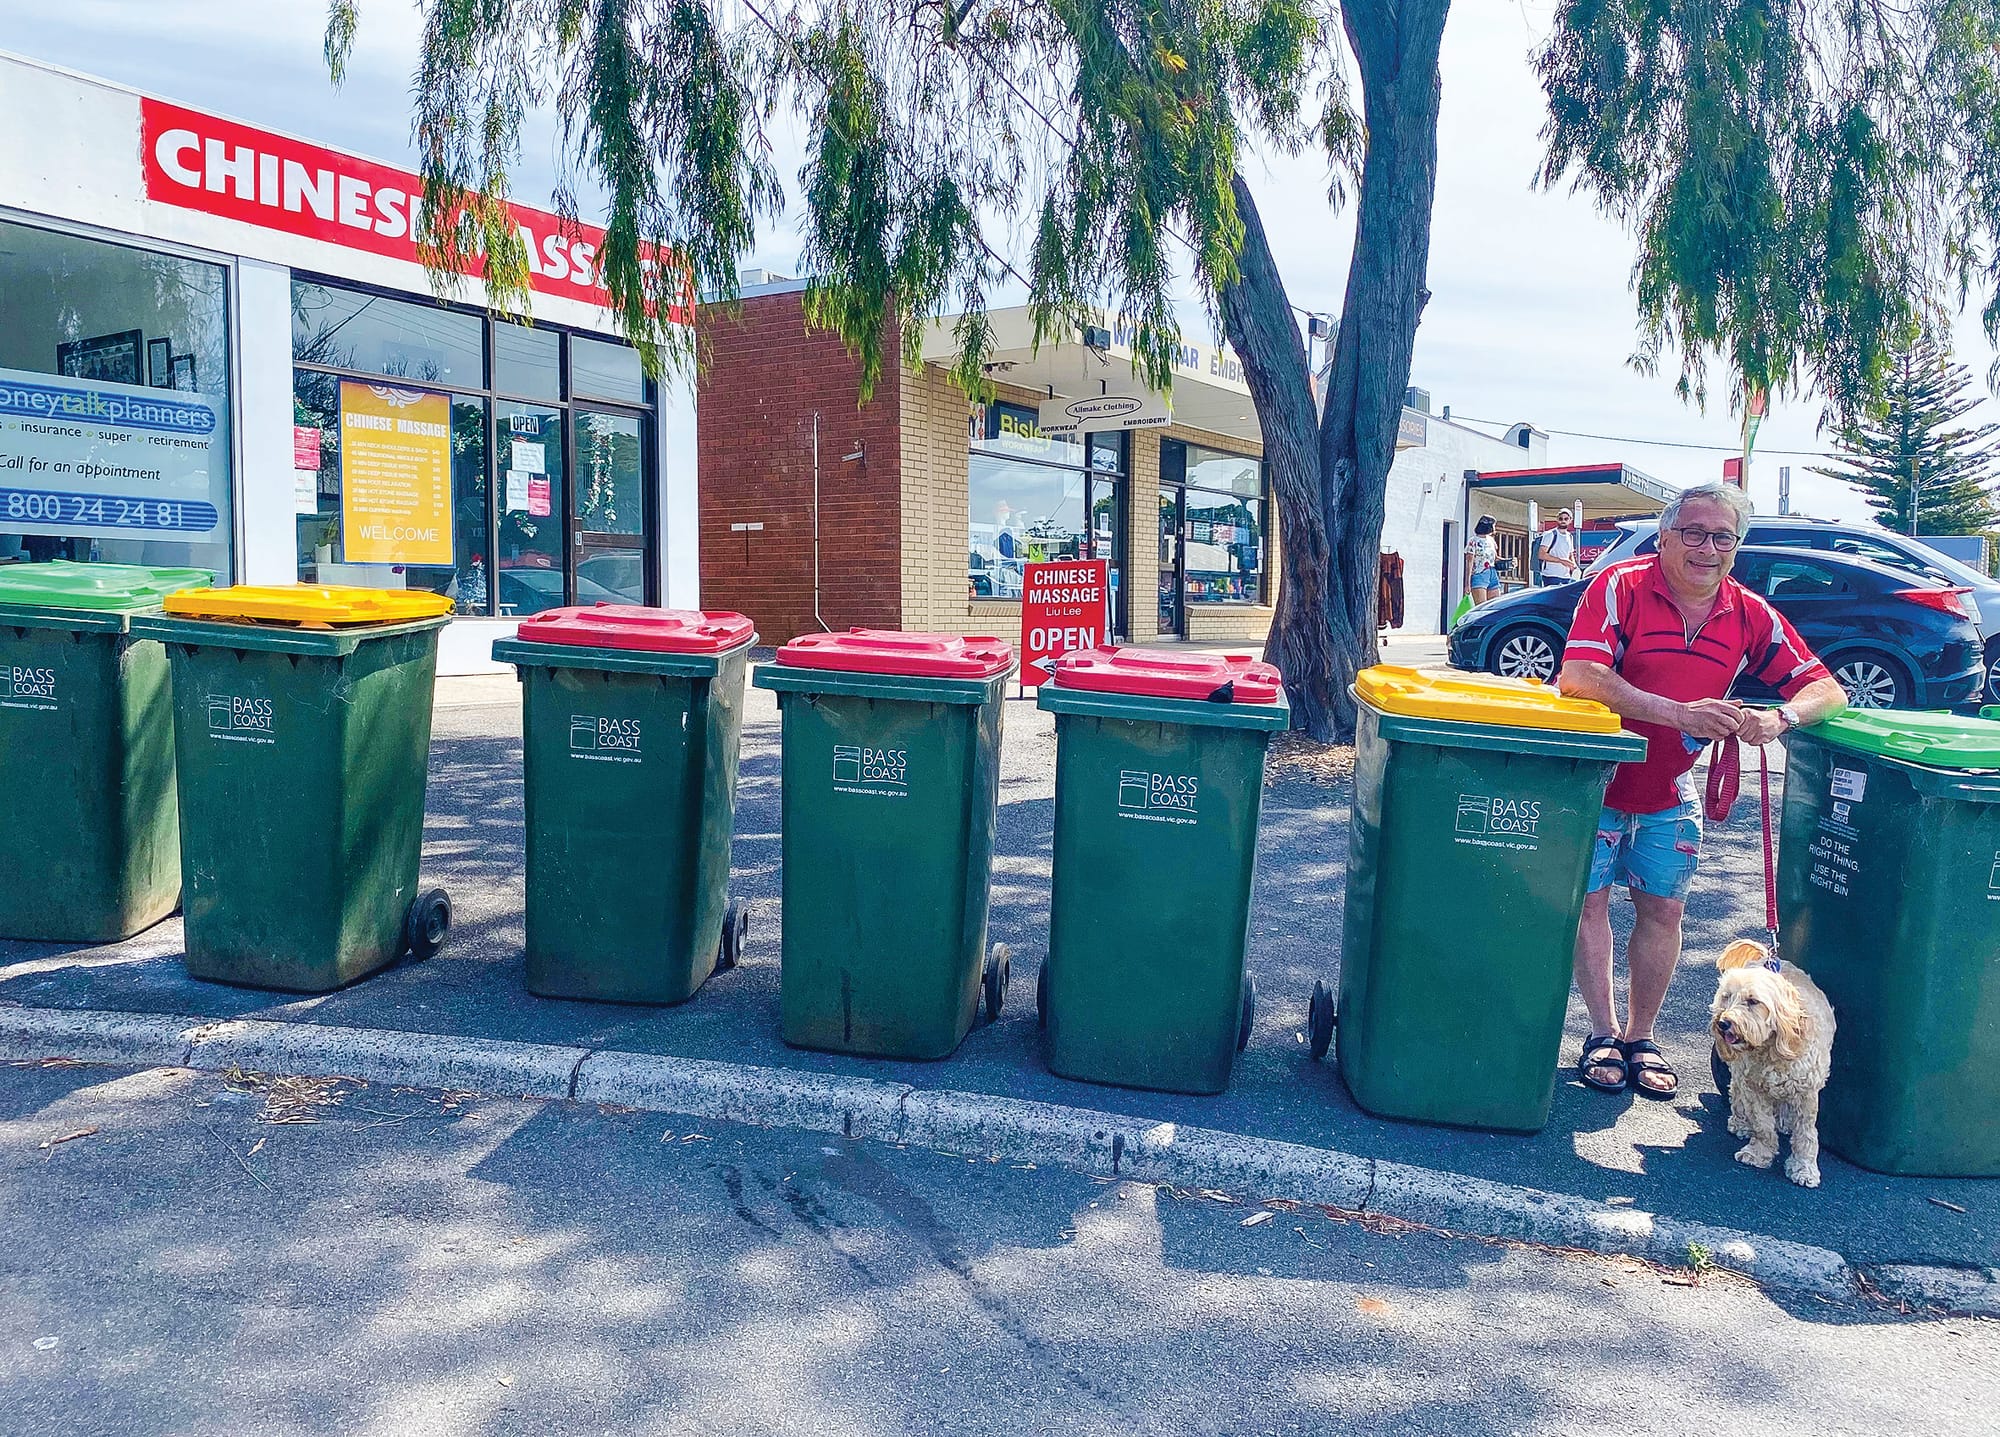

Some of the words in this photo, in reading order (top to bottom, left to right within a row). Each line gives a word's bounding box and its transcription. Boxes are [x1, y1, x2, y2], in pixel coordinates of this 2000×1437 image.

[1072, 403, 1102, 414] Allmake
[1103, 401, 1135, 412] Clothing
[346, 413, 393, 432] CHINESE
[397, 419, 447, 438] MASSAGE
[513, 416, 537, 432] OPEN
[1040, 424, 1078, 433] WORKWEAR
[1123, 417, 1166, 426] EMBROIDERY
[21, 421, 82, 437] insurance
[98, 430, 132, 444] super
[148, 436, 209, 449] retirement
[1001, 414, 1052, 450] Bisley
[0, 455, 24, 469] Call
[29, 457, 49, 473] for
[54, 461, 71, 473] an
[76, 464, 161, 480] appointment
[8, 493, 61, 520] 800
[71, 497, 104, 522] 24
[115, 500, 147, 525] 24
[156, 503, 182, 526] 81
[359, 525, 440, 542] WELCOME
[1034, 569, 1096, 585] CHINESE
[1029, 587, 1099, 604] MASSAGE
[1046, 607, 1061, 616] Liu
[1063, 607, 1082, 616] Lee
[1030, 627, 1095, 651] OPEN
[13, 666, 55, 684] BASS
[13, 683, 55, 695] COAST
[233, 697, 273, 716] BASS
[233, 714, 272, 728] COAST
[598, 717, 641, 736] BASS
[598, 735, 640, 748] COAST
[863, 748, 907, 767] BASS
[863, 766, 906, 780] COAST
[1151, 773, 1198, 794] BASS
[1151, 792, 1197, 808] COAST
[1492, 798, 1541, 819] BASS
[1118, 812, 1197, 825] www.basscoast.vic.gov.au
[1490, 817, 1539, 833] COAST
[1809, 844, 1832, 860] RIGHT
[1820, 836, 1832, 849] DO
[1833, 840, 1850, 856] THE
[1814, 862, 1830, 877] USE
[1831, 868, 1848, 884] THE
[1810, 874, 1832, 890] RIGHT
[1833, 882, 1849, 897] BIN
